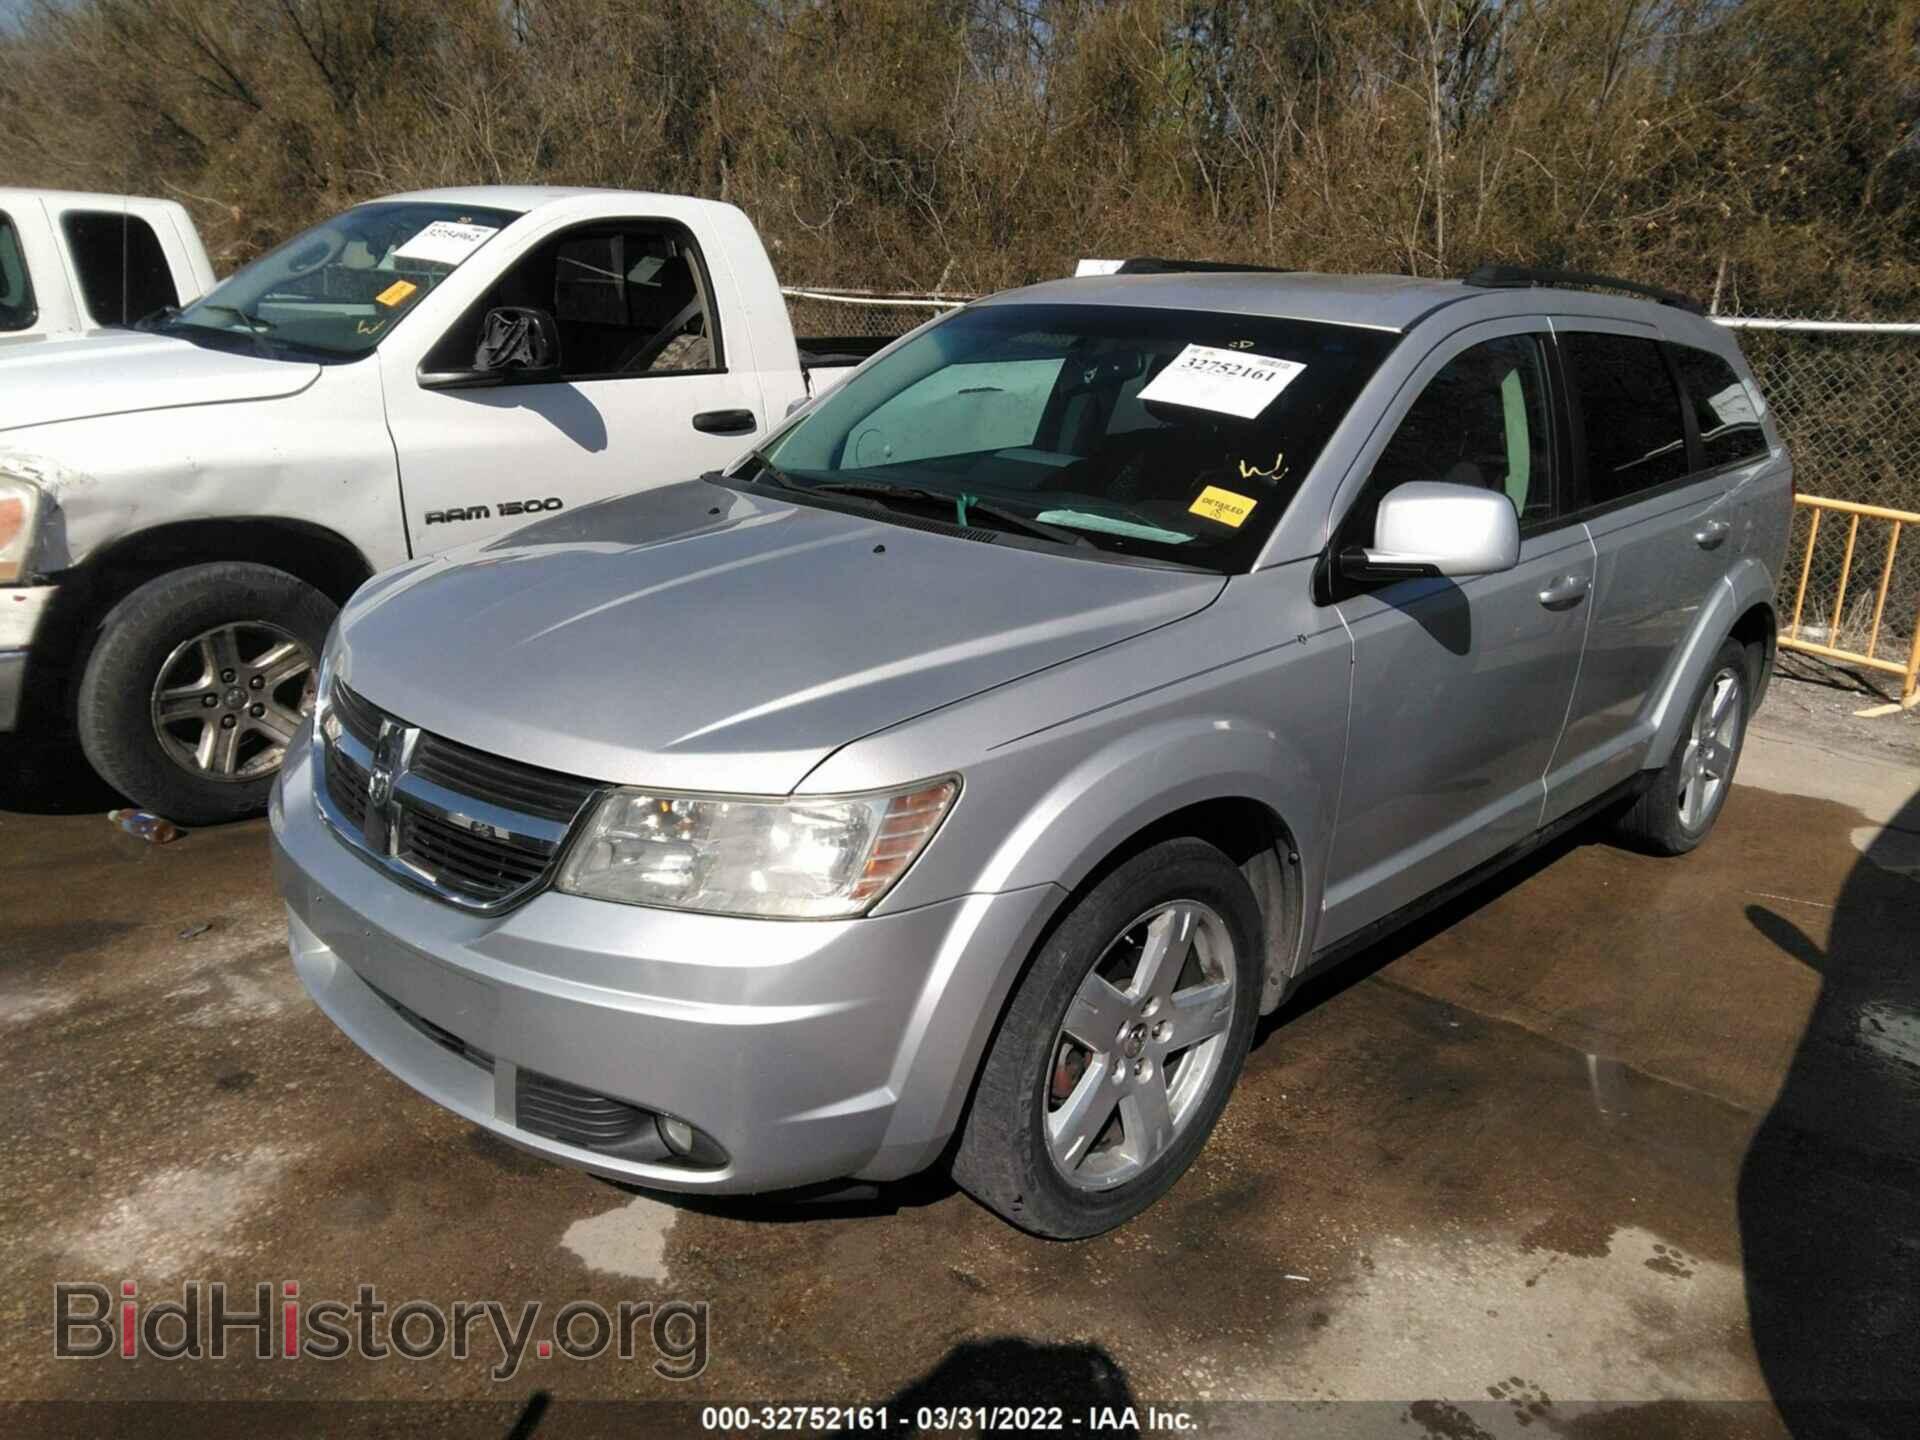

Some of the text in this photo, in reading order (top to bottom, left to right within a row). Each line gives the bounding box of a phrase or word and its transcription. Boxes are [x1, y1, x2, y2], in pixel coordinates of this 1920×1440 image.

[1181, 356, 1277, 383] 32752161
[425, 497, 563, 525] RAM 1500
[1202, 497, 1245, 515] DETAILED
